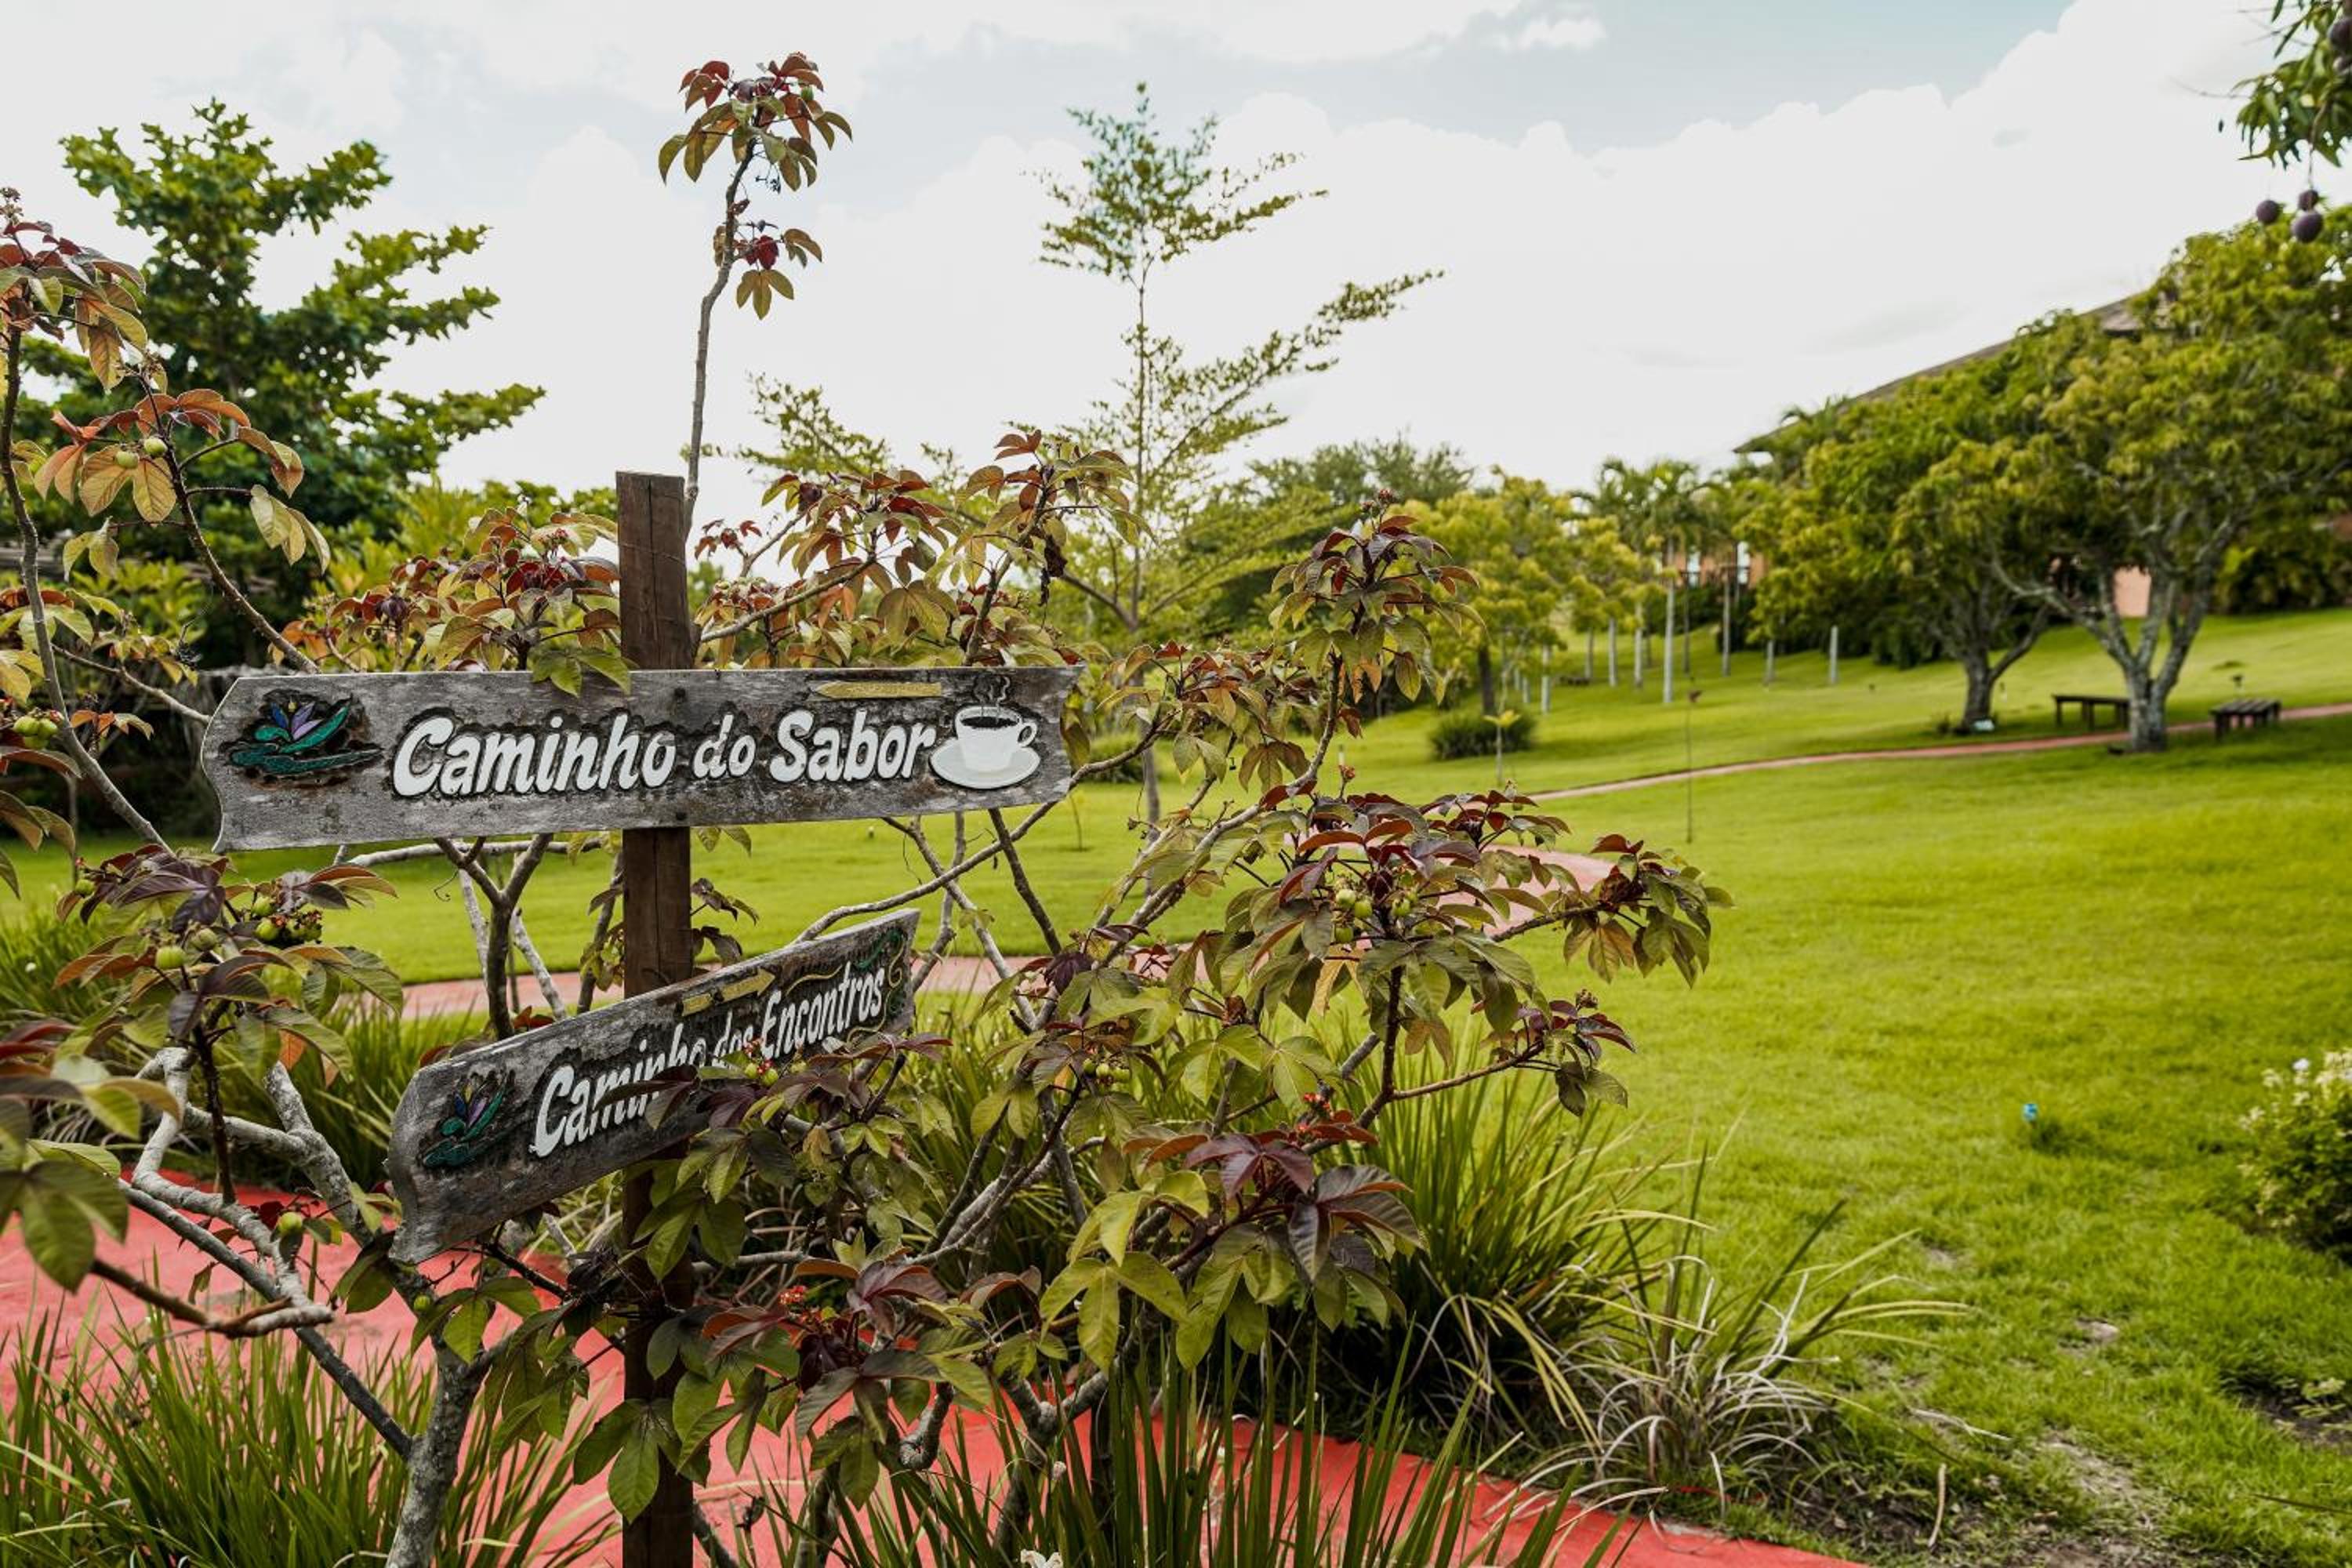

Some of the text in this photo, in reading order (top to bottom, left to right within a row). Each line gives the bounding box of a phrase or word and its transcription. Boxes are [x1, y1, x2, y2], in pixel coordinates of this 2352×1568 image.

[394, 709, 937, 797] Caminho do Sabor
[760, 960, 885, 1060] Encontros
